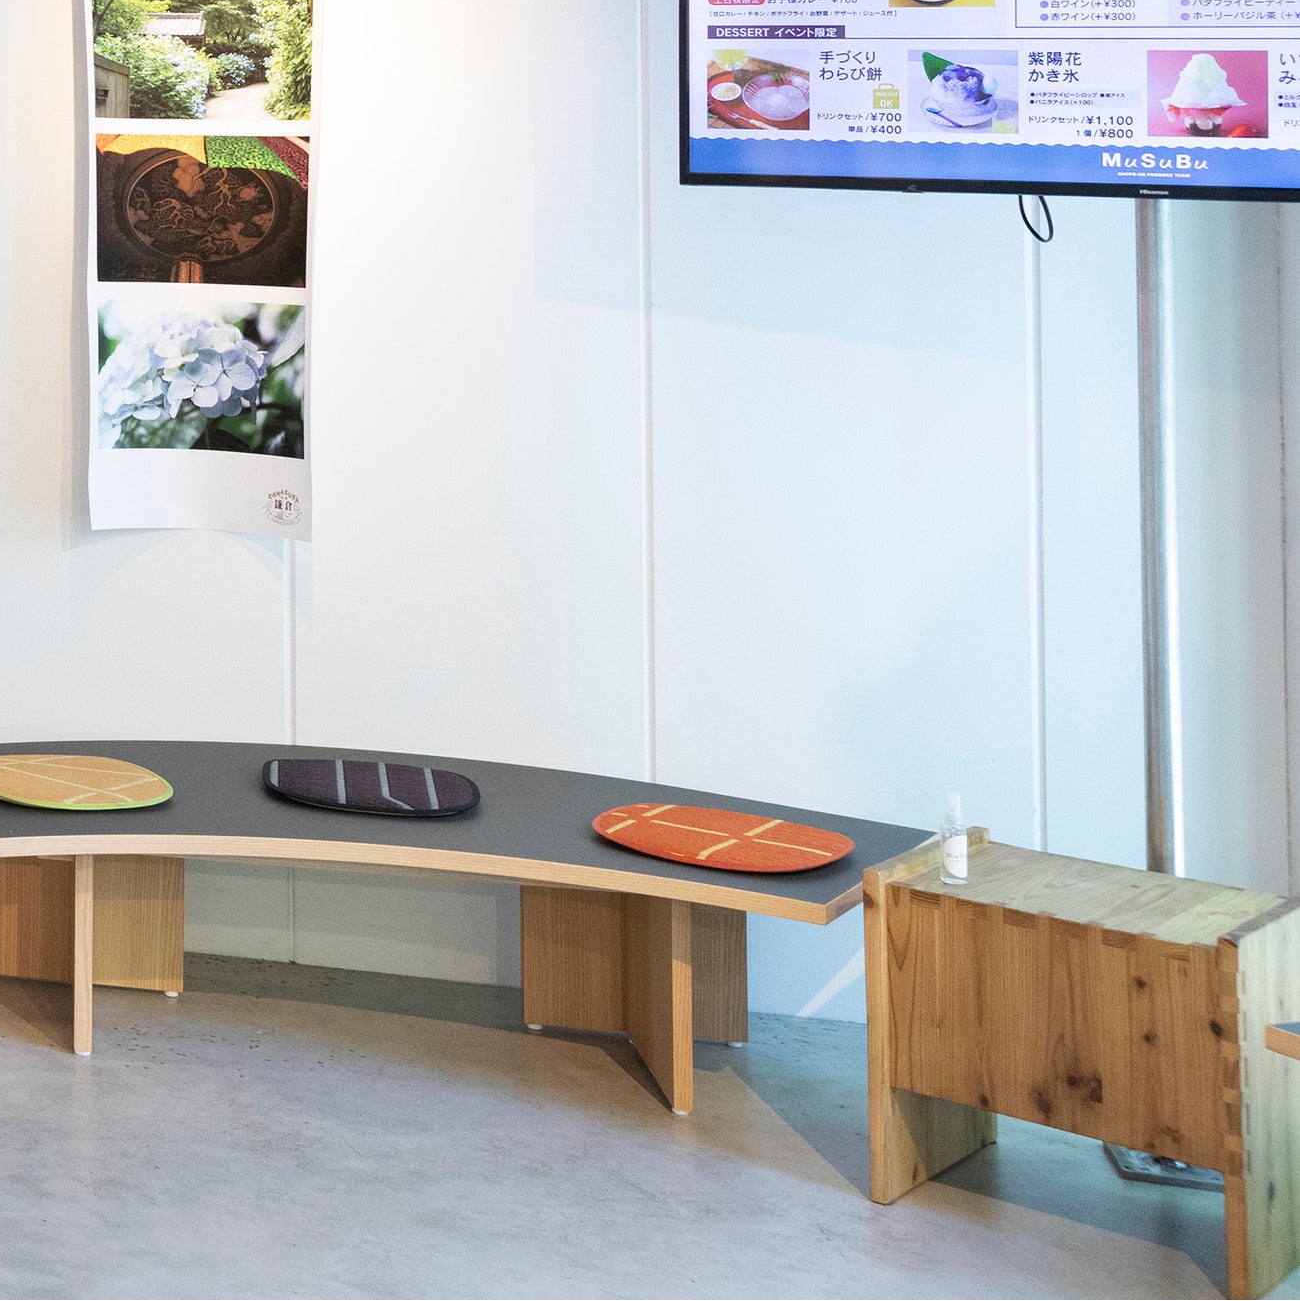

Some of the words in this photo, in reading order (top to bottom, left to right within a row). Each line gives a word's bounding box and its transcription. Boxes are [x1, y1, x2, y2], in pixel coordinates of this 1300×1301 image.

[1192, 11, 1277, 21] ホーリーバジル茶
[716, 27, 770, 38] DESSERT
[774, 27, 838, 38] イベント限定
[819, 50, 877, 64] 手づくり
[1028, 51, 1083, 67] 紫陽花
[819, 66, 883, 82] わらび餅
[1028, 68, 1081, 83] かき氷
[880, 99, 894, 108] OK
[1102, 152, 1209, 170] MuSuBu
